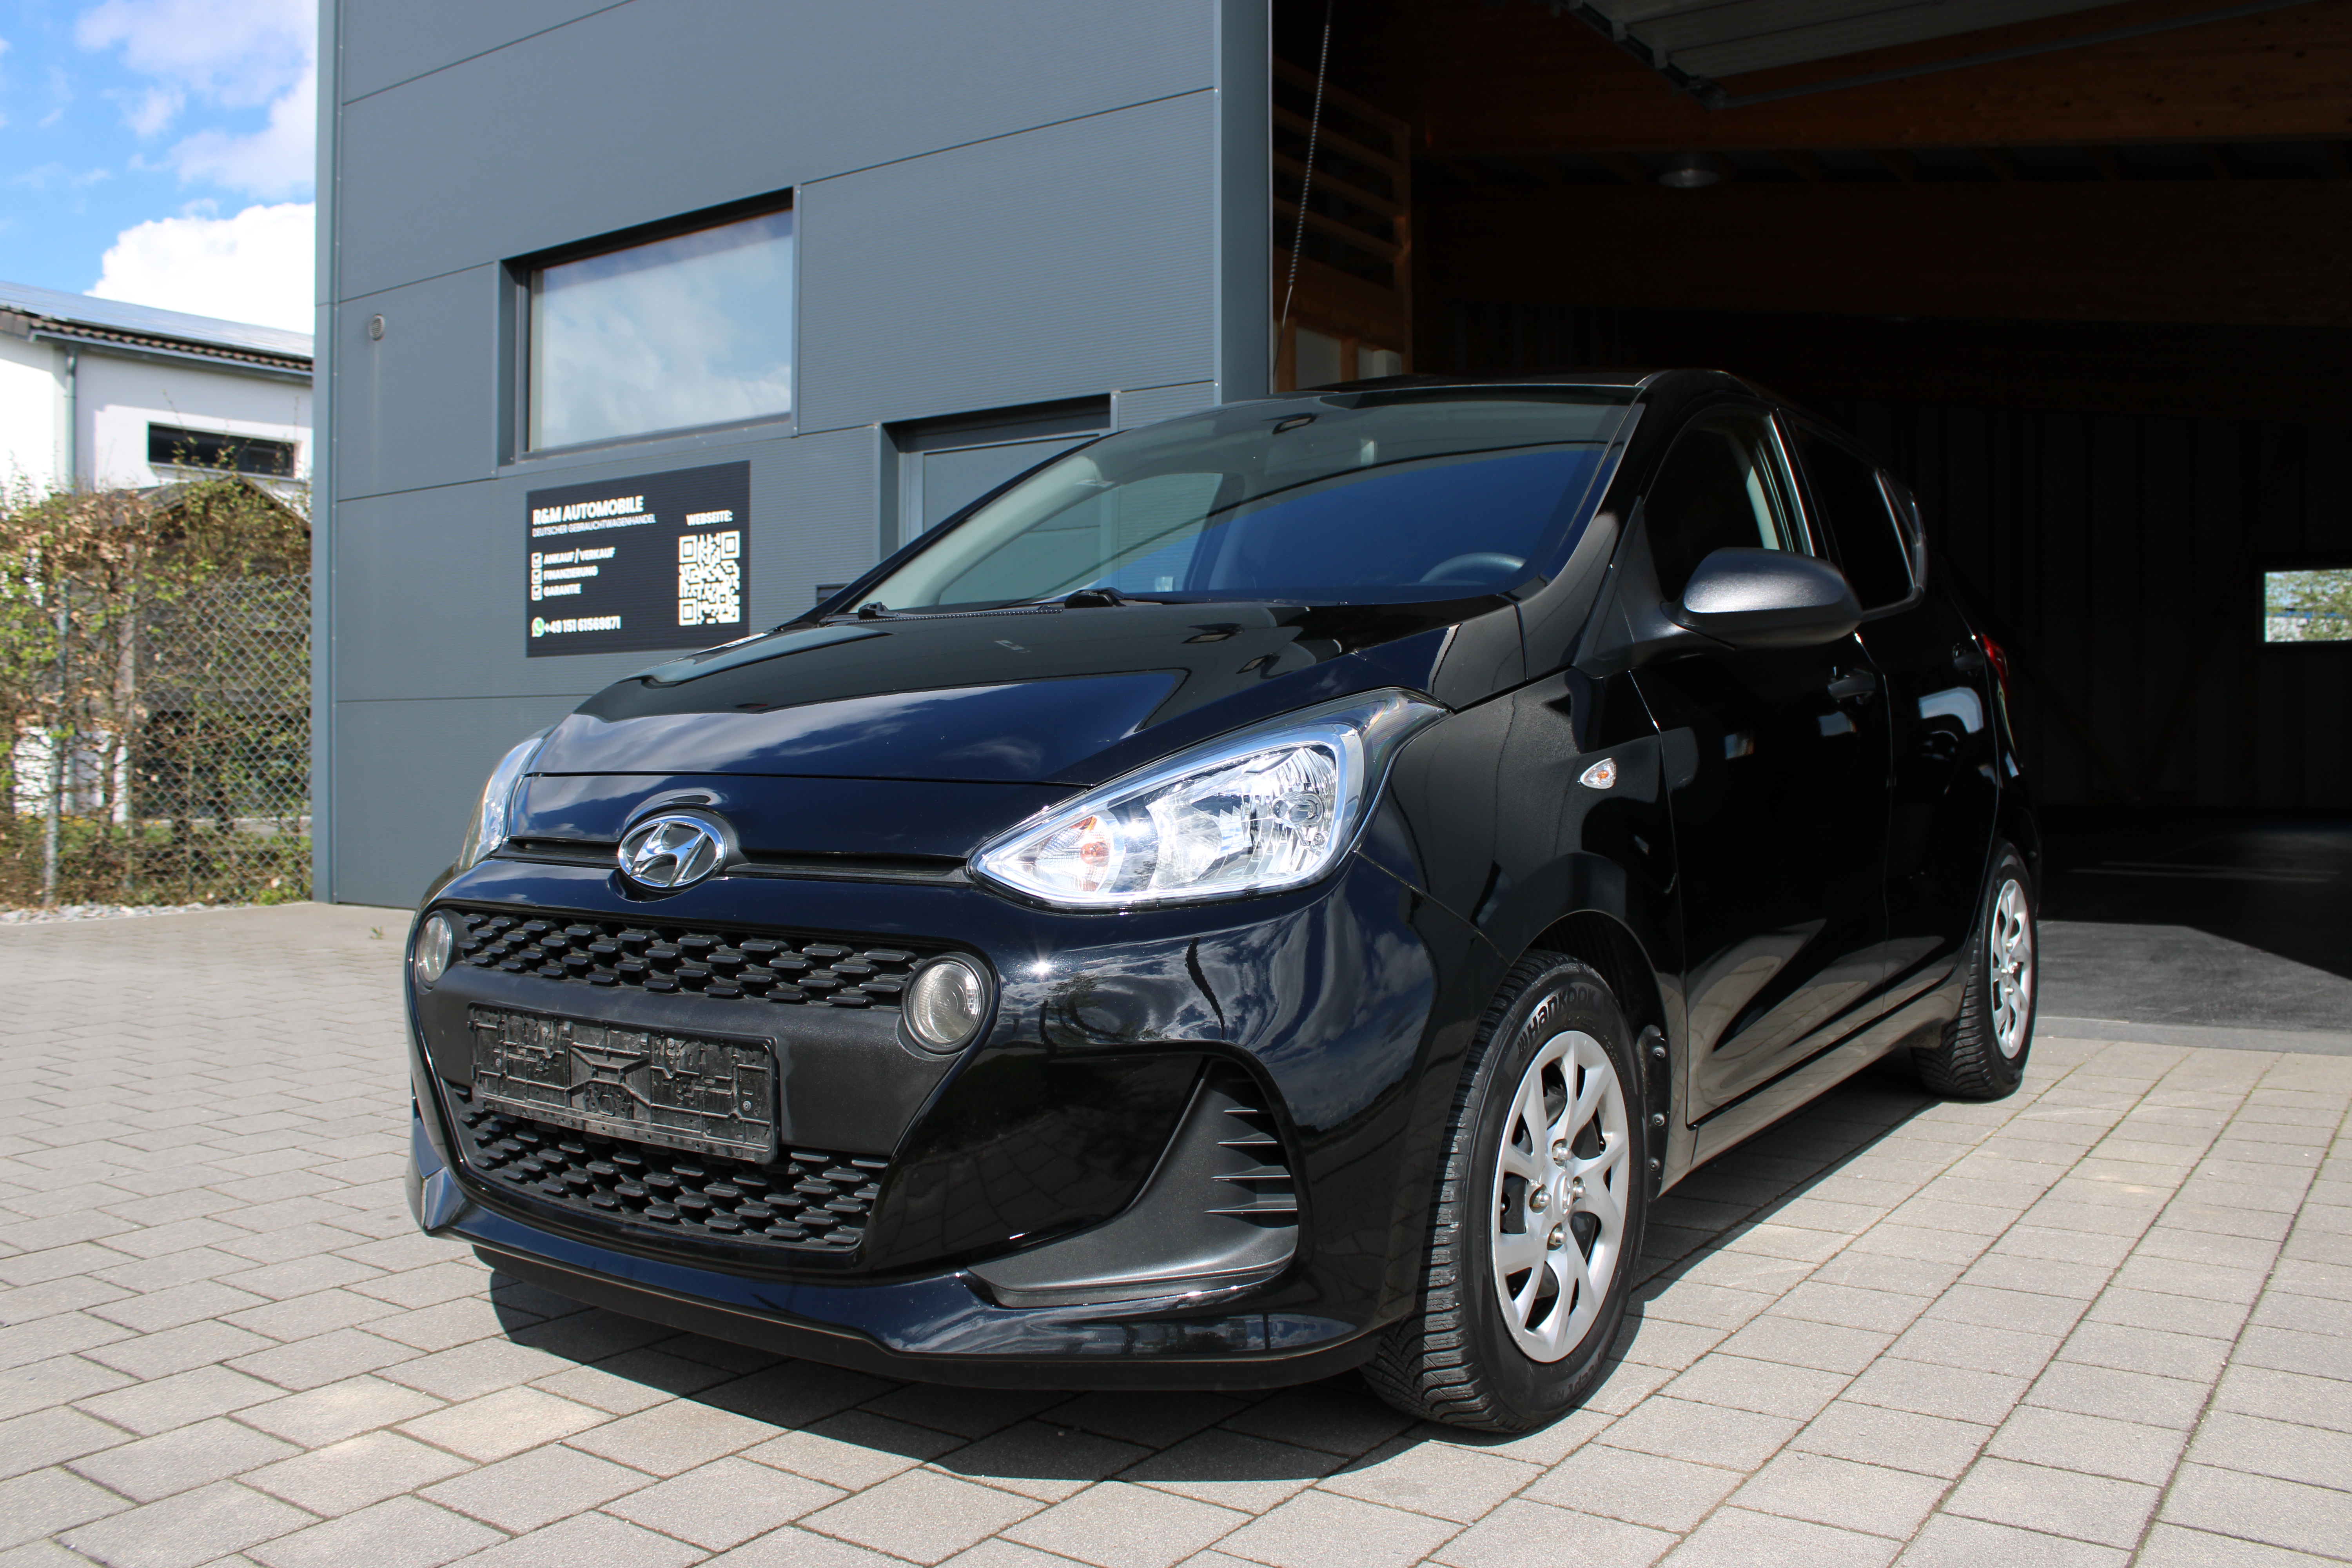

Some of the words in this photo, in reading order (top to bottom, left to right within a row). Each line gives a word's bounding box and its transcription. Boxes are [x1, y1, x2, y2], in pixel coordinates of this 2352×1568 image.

[532, 506, 562, 525] R&M
[562, 495, 644, 522] AUTOMOBILE
[686, 510, 733, 526] WEBSEITE:
[532, 524, 568, 537] DEUTSCHER
[568, 514, 657, 533] GEBRAUCHTWAGENHANDEL
[543, 565, 599, 581] FINANZIERUNG
[543, 583, 582, 597] GARANTIE
[562, 619, 577, 633] 151
